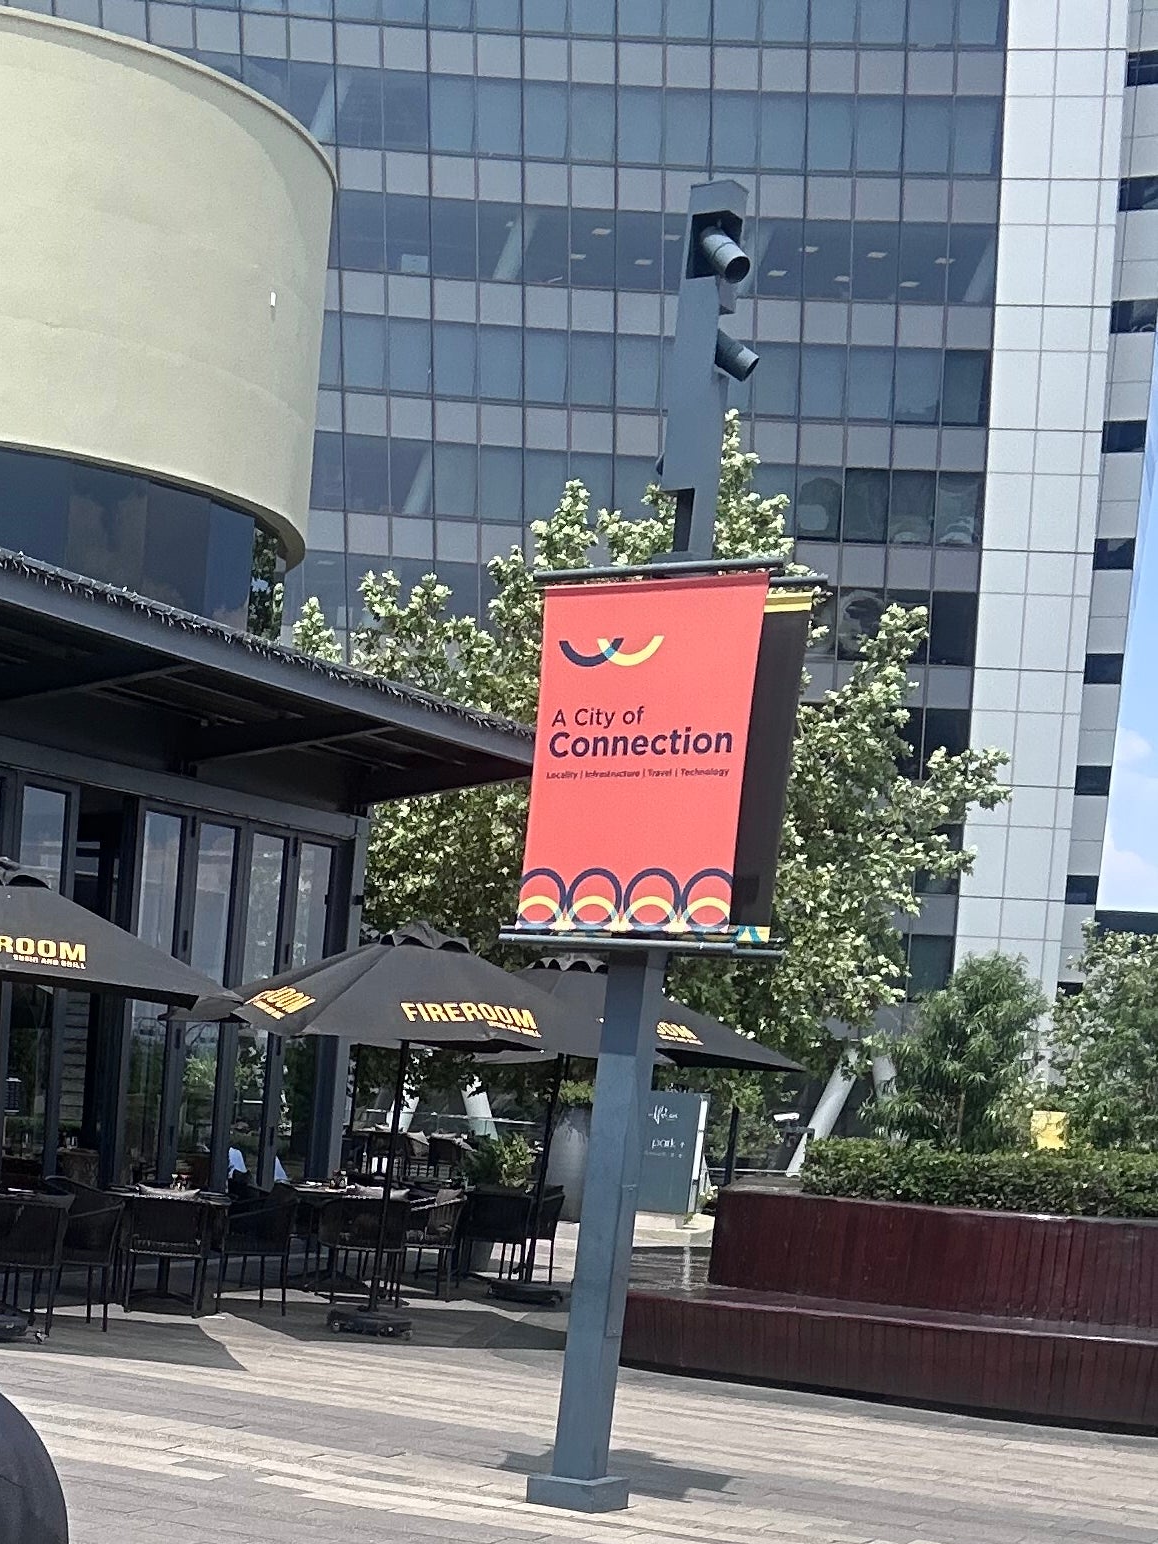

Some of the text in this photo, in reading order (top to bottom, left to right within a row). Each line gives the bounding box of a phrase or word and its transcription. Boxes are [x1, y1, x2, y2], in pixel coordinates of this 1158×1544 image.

[551, 706, 644, 729] A City of
[549, 727, 733, 758] Connection
[400, 1002, 538, 1030] FIREROOM
